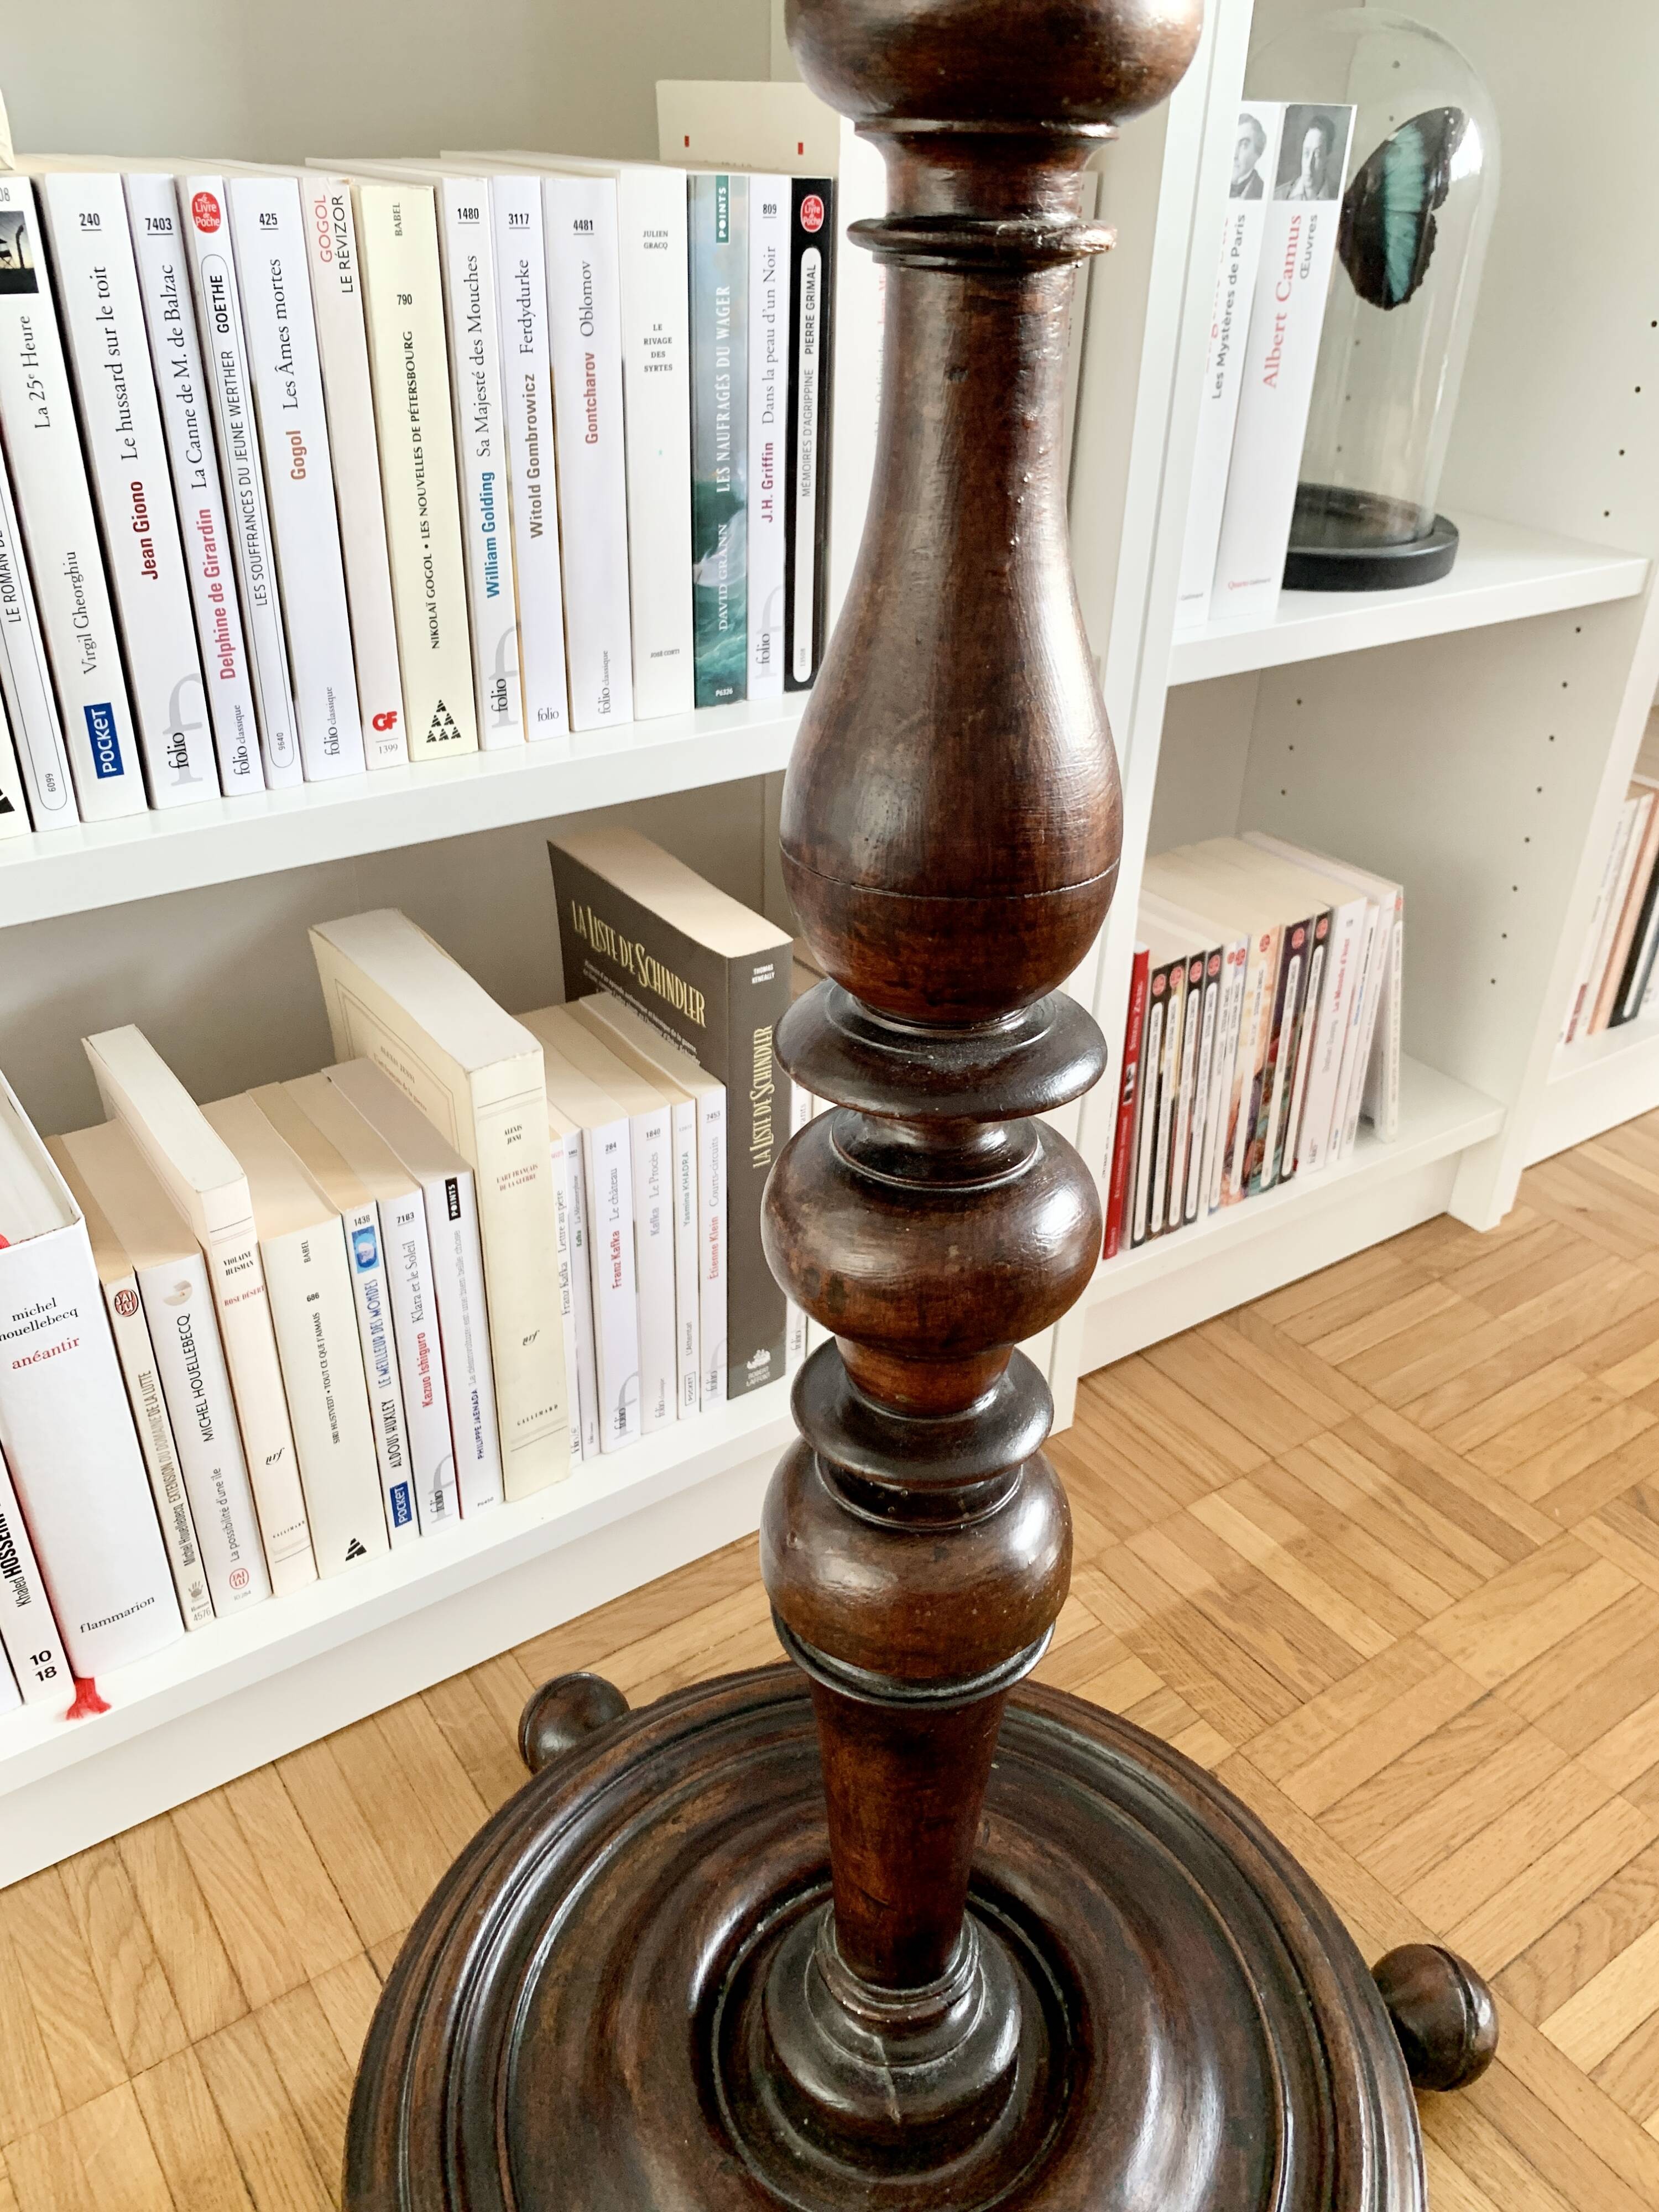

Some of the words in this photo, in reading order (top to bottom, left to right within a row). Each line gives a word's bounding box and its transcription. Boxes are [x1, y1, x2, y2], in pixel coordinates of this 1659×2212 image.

[79, 213, 100, 226] 240
[145, 218, 173, 231] 7403
[259, 213, 277, 226] 425
[314, 195, 332, 263] GOGOL
[393, 202, 403, 237] BABEL
[458, 208, 479, 220] 1480
[509, 213, 529, 225] 3117
[573, 220, 593, 231] 4481
[332, 195, 351, 270] RÉVIZOR
[1232, 214, 1245, 257] Paris
[1300, 215, 1317, 279] Œuvres
[763, 246, 775, 283] Noir
[1229, 265, 1238, 284] de
[90, 267, 110, 298] toit
[160, 265, 180, 321] Balzac
[270, 259, 287, 320] mortes
[340, 275, 353, 293] LE
[463, 255, 482, 333] Mouches
[806, 264, 816, 310] GRIMAL
[96, 305, 114, 321] le
[210, 275, 229, 333] GOETHE
[397, 294, 413, 305] 790
[515, 259, 535, 354] Ferdydurke
[579, 260, 594, 337] Oblomov
[717, 286, 730, 340] WAGER
[763, 289, 775, 324] d'un
[1263, 313, 1287, 389] Albert
[1276, 215, 1301, 302] Camus
[20, 316, 39, 368] Heure
[105, 328, 120, 356] sur
[168, 328, 185, 347] de
[805, 315, 814, 354] PIERRE
[1217, 290, 1234, 366] Mystères
[275, 326, 294, 375] Âmes
[469, 339, 484, 366] des
[717, 346, 730, 368] DU
[767, 328, 779, 363] peau
[174, 354, 190, 378] M.
[403, 331, 419, 422] PÉTERSBOURG
[762, 368, 775, 382] la
[105, 363, 133, 431] hussard
[176, 384, 194, 404] de
[221, 351, 241, 416] WERTHER
[283, 380, 298, 410] Les
[583, 352, 598, 444] Gontcharov
[1212, 373, 1224, 399] Les
[472, 372, 491, 433] Majesté
[714, 373, 730, 461] NAUFRAGÉS
[762, 385, 774, 424] Dans
[803, 369, 813, 436] D'AGRIPPINE
[34, 407, 50, 429] La
[523, 374, 540, 478] Gombrowicz
[121, 438, 138, 460] Le
[186, 409, 202, 463] Canne
[232, 421, 248, 462] JEUNE
[412, 426, 421, 442] DE
[477, 439, 490, 457] Sa
[285, 430, 307, 480] Gogol
[762, 442, 774, 490] Griffin
[802, 440, 812, 497] MÉMOIRES
[191, 469, 207, 489] La
[238, 468, 251, 485] DU
[414, 446, 428, 516] NOUVELLES
[717, 467, 730, 492] LES
[131, 481, 150, 533] Giono
[479, 472, 495, 533] Golding
[528, 484, 544, 539] Witold
[196, 509, 220, 578] Girardin
[241, 490, 264, 580] SOUFFRANCES
[420, 521, 430, 539] LES
[141, 538, 158, 580] Jean
[484, 537, 499, 598] William
[424, 554, 436, 598] GOGOL
[207, 582, 225, 602] de
[255, 585, 267, 606] LES
[719, 583, 728, 631] DAVID
[6, 607, 21, 623] LE
[426, 602, 440, 649] NIKOLAÏ
[76, 633, 97, 675] Virgil
[213, 607, 236, 680] Delphine
[234, 705, 245, 744] classique
[538, 707, 559, 721] folio
[233, 745, 251, 775] folio
[752, 972, 775, 984] KENEALLY
[753, 964, 774, 975] THOMAS
[504, 1124, 523, 1136] ALEXIS
[706, 1110, 721, 1120] 7453
[507, 1134, 522, 1145] JENNI
[606, 1142, 617, 1151] 284
[646, 1128, 660, 1138] 1840
[608, 1168, 618, 1205] château
[708, 1136, 719, 1207] Courts-circuits
[449, 1184, 458, 1217] POINTS
[650, 1185, 659, 1199] Le
[354, 1215, 371, 1226] 1438
[397, 1212, 414, 1224] 7183
[609, 1207, 619, 1222] Le
[650, 1207, 659, 1237] Kafka
[709, 1216, 719, 1242] Klein
[223, 1251, 252, 1266] VIOLAINE
[301, 1240, 310, 1264] BABEL
[402, 1240, 418, 1270] Soleil
[611, 1230, 620, 1261] Kafka
[226, 1260, 254, 1276] HUISMAN
[407, 1270, 419, 1282] le
[559, 1261, 568, 1288] Kafka
[613, 1262, 621, 1290] Franz
[307, 1292, 320, 1302] 686
[364, 1279, 381, 1318] MONDES
[412, 1282, 419, 1292] et
[12, 1297, 58, 1322] michel
[411, 1295, 423, 1323] Klara
[562, 1290, 570, 1316] Franz
[312, 1312, 325, 1342] J'AIMAIS
[370, 1318, 383, 1334] DES
[12, 1337, 80, 1369] anéantir
[177, 1313, 205, 1399] HOUELLEBECQ
[317, 1342, 327, 1358] QUE
[320, 1359, 328, 1368] CE
[373, 1334, 390, 1376] MEILLEUR
[417, 1332, 430, 1375] Ishiguro
[138, 1370, 155, 1395] LUTTE
[322, 1370, 331, 1389] TOUT
[378, 1376, 392, 1388] LE
[422, 1376, 433, 1407] Kazuo
[195, 1399, 214, 1442] MICHEL
[326, 1396, 337, 1431] HUSTVEDT
[382, 1399, 395, 1434] HUXLEY
[386, 1433, 401, 1468] ALDOUS
[474, 1425, 484, 1459] PHILIPPE
[160, 1462, 180, 1503] EXTENSION
[216, 1481, 227, 1504] d'une
[173, 1503, 190, 1545] Houellebecq
[220, 1507, 240, 1550] possibilité
[180, 1542, 195, 1566] Michel
[231, 1550, 240, 1562] La
[9, 1576, 32, 1607] Khaled
[80, 1597, 155, 1634] flammarion
[194, 1609, 211, 1621] 4576
[30, 1650, 51, 1665] 10
[35, 1667, 57, 1682] 18
